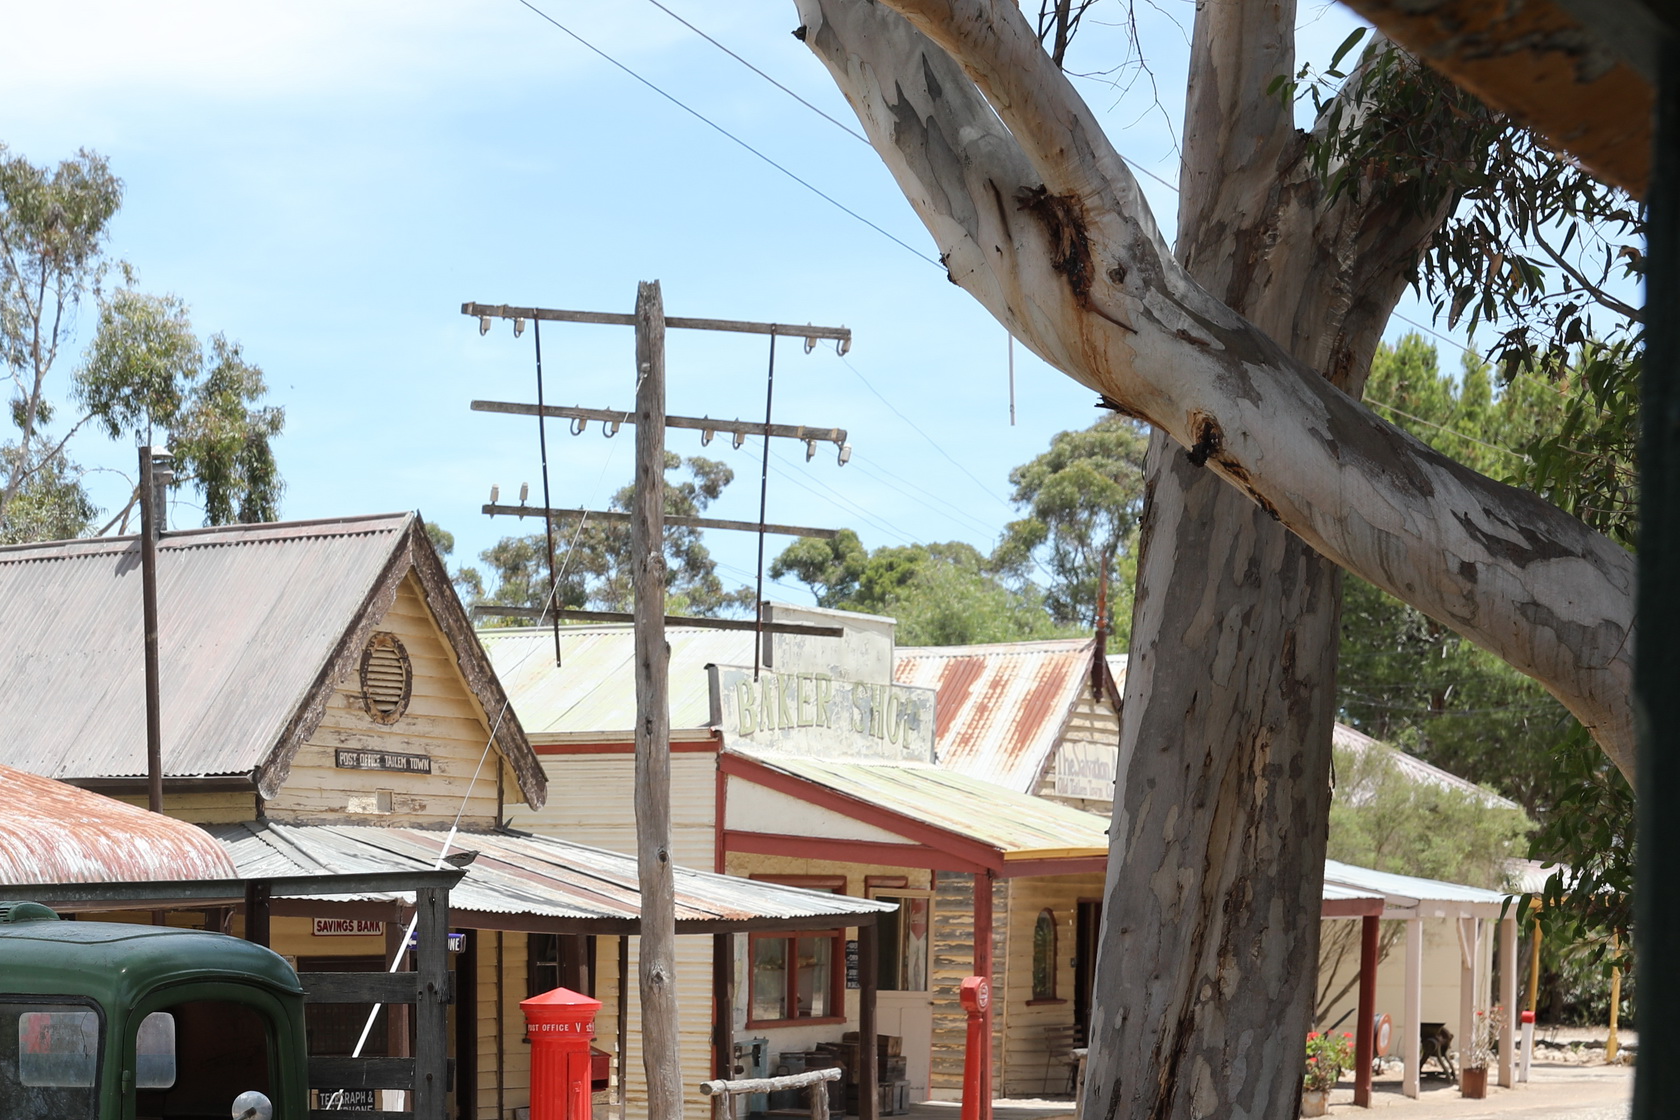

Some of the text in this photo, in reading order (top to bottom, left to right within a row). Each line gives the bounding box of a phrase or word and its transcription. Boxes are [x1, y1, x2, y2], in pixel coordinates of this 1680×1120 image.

[735, 672, 921, 750] BAKER SHOP
[339, 752, 357, 766] POST
[384, 755, 407, 769] TAILEM
[409, 757, 430, 771] TOWN
[316, 919, 381, 933] SAVINGS BANK
[541, 1023, 569, 1032] OFFICE
[367, 1090, 374, 1103] &
